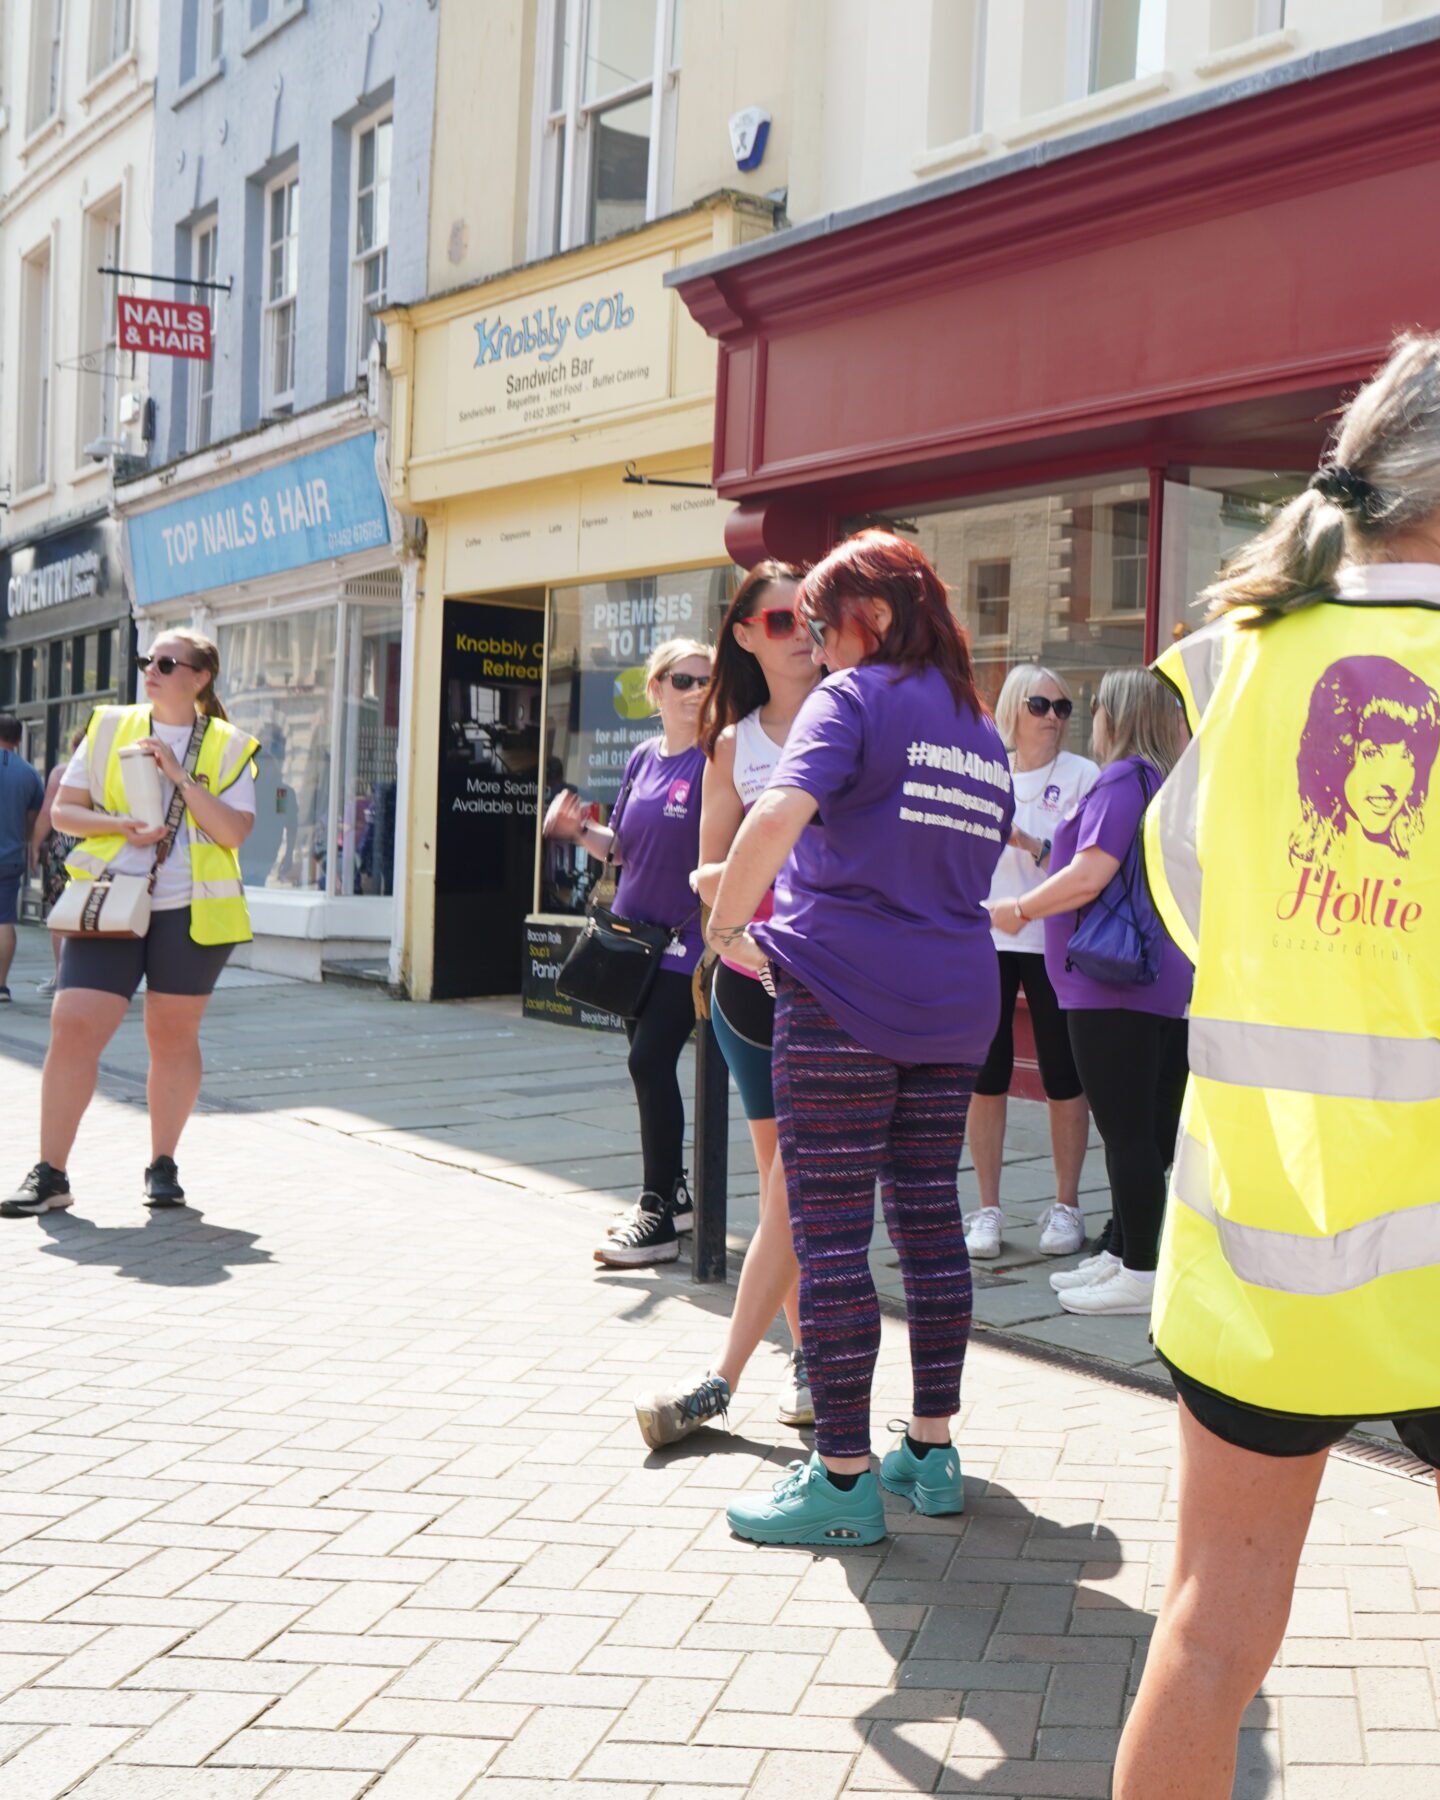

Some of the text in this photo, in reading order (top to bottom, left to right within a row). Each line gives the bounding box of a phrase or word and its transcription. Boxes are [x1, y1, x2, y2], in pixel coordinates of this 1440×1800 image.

[124, 302, 204, 333] NAILS
[125, 325, 205, 353] & HAIR
[474, 305, 570, 369] Knobbly
[506, 357, 594, 394] Sandwich Bar
[459, 366, 649, 422] Sandwiches Baguettes Hot Food Buffet Catering
[162, 478, 332, 566] TOP NAILS & HAIR
[632, 508, 652, 520] Mocha
[683, 497, 715, 512] Chocolate
[7, 556, 73, 618] COVENTRY
[593, 593, 692, 630] PREMISES
[456, 634, 527, 659] Knobbly
[608, 628, 634, 657] TO
[596, 728, 610, 744] for
[612, 727, 626, 743] all
[588, 750, 608, 766] call
[467, 778, 500, 794] More
[452, 797, 513, 814] Available
[1276, 866, 1423, 936] Hollie
[527, 929, 547, 943] Bacon
[548, 931, 562, 944] Rolls
